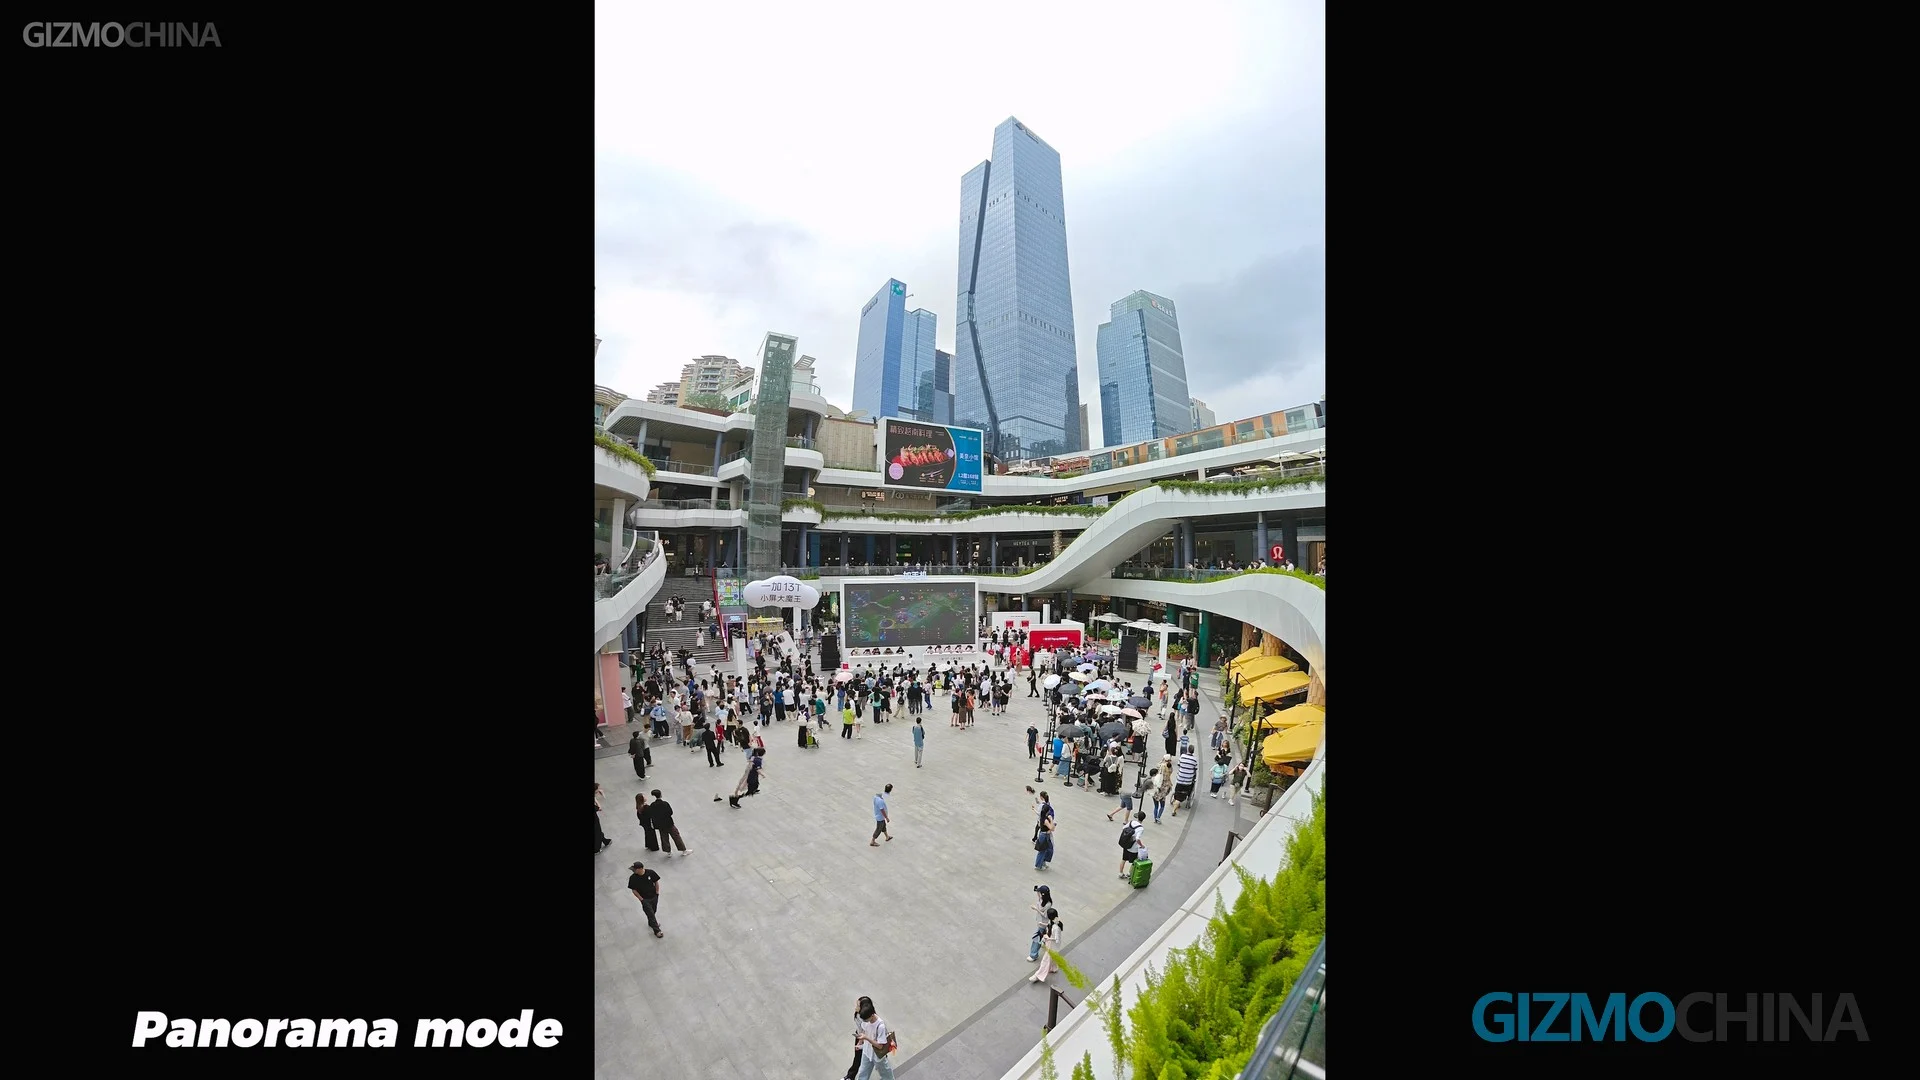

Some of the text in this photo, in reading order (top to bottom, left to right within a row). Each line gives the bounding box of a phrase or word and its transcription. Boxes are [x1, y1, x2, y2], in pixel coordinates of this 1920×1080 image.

[761, 582, 802, 592] 一加 13T
[760, 594, 802, 603] 小屏大魔王
